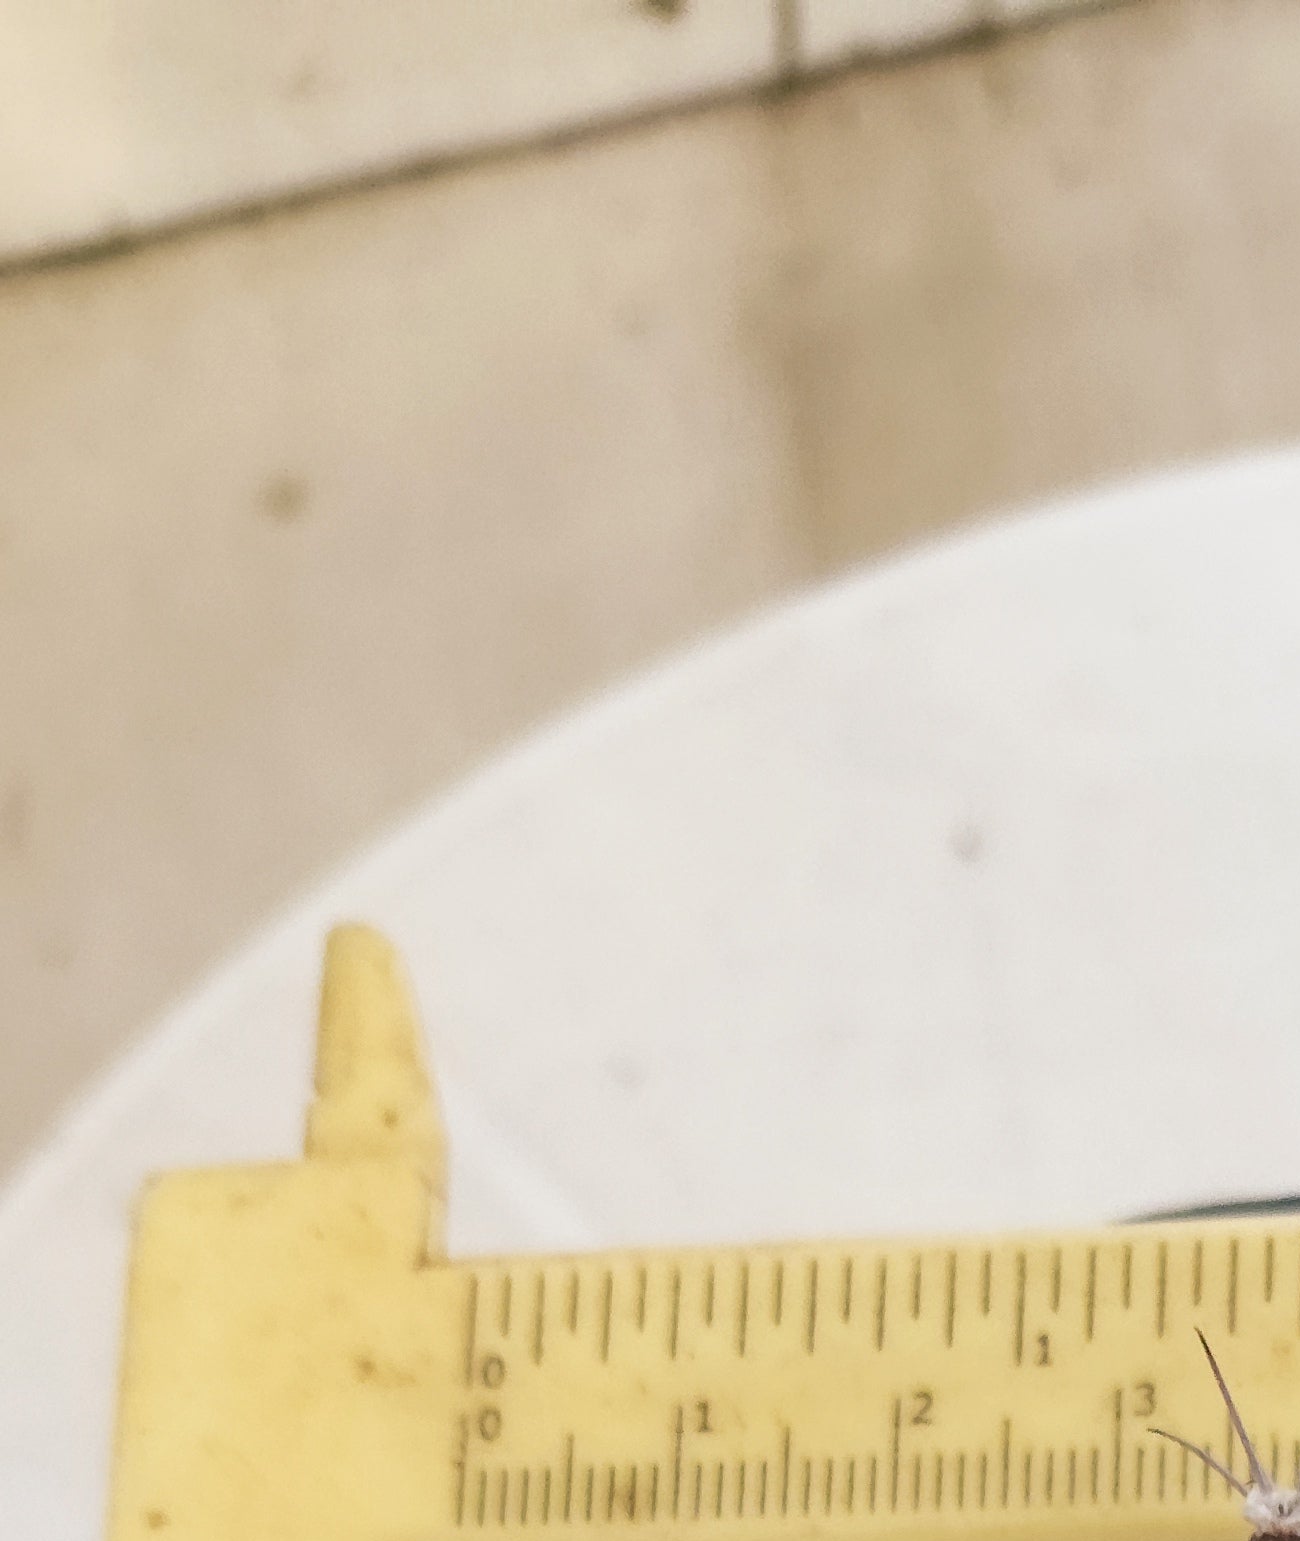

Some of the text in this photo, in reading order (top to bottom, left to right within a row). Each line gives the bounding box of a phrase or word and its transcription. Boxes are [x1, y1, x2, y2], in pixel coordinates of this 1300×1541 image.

[481, 1354, 506, 1389] 0
[1037, 1332, 1051, 1367] 1
[478, 1407, 502, 1441] 0
[697, 1400, 713, 1434] 1
[911, 1390, 934, 1425] 2
[1133, 1381, 1157, 1417] 3
